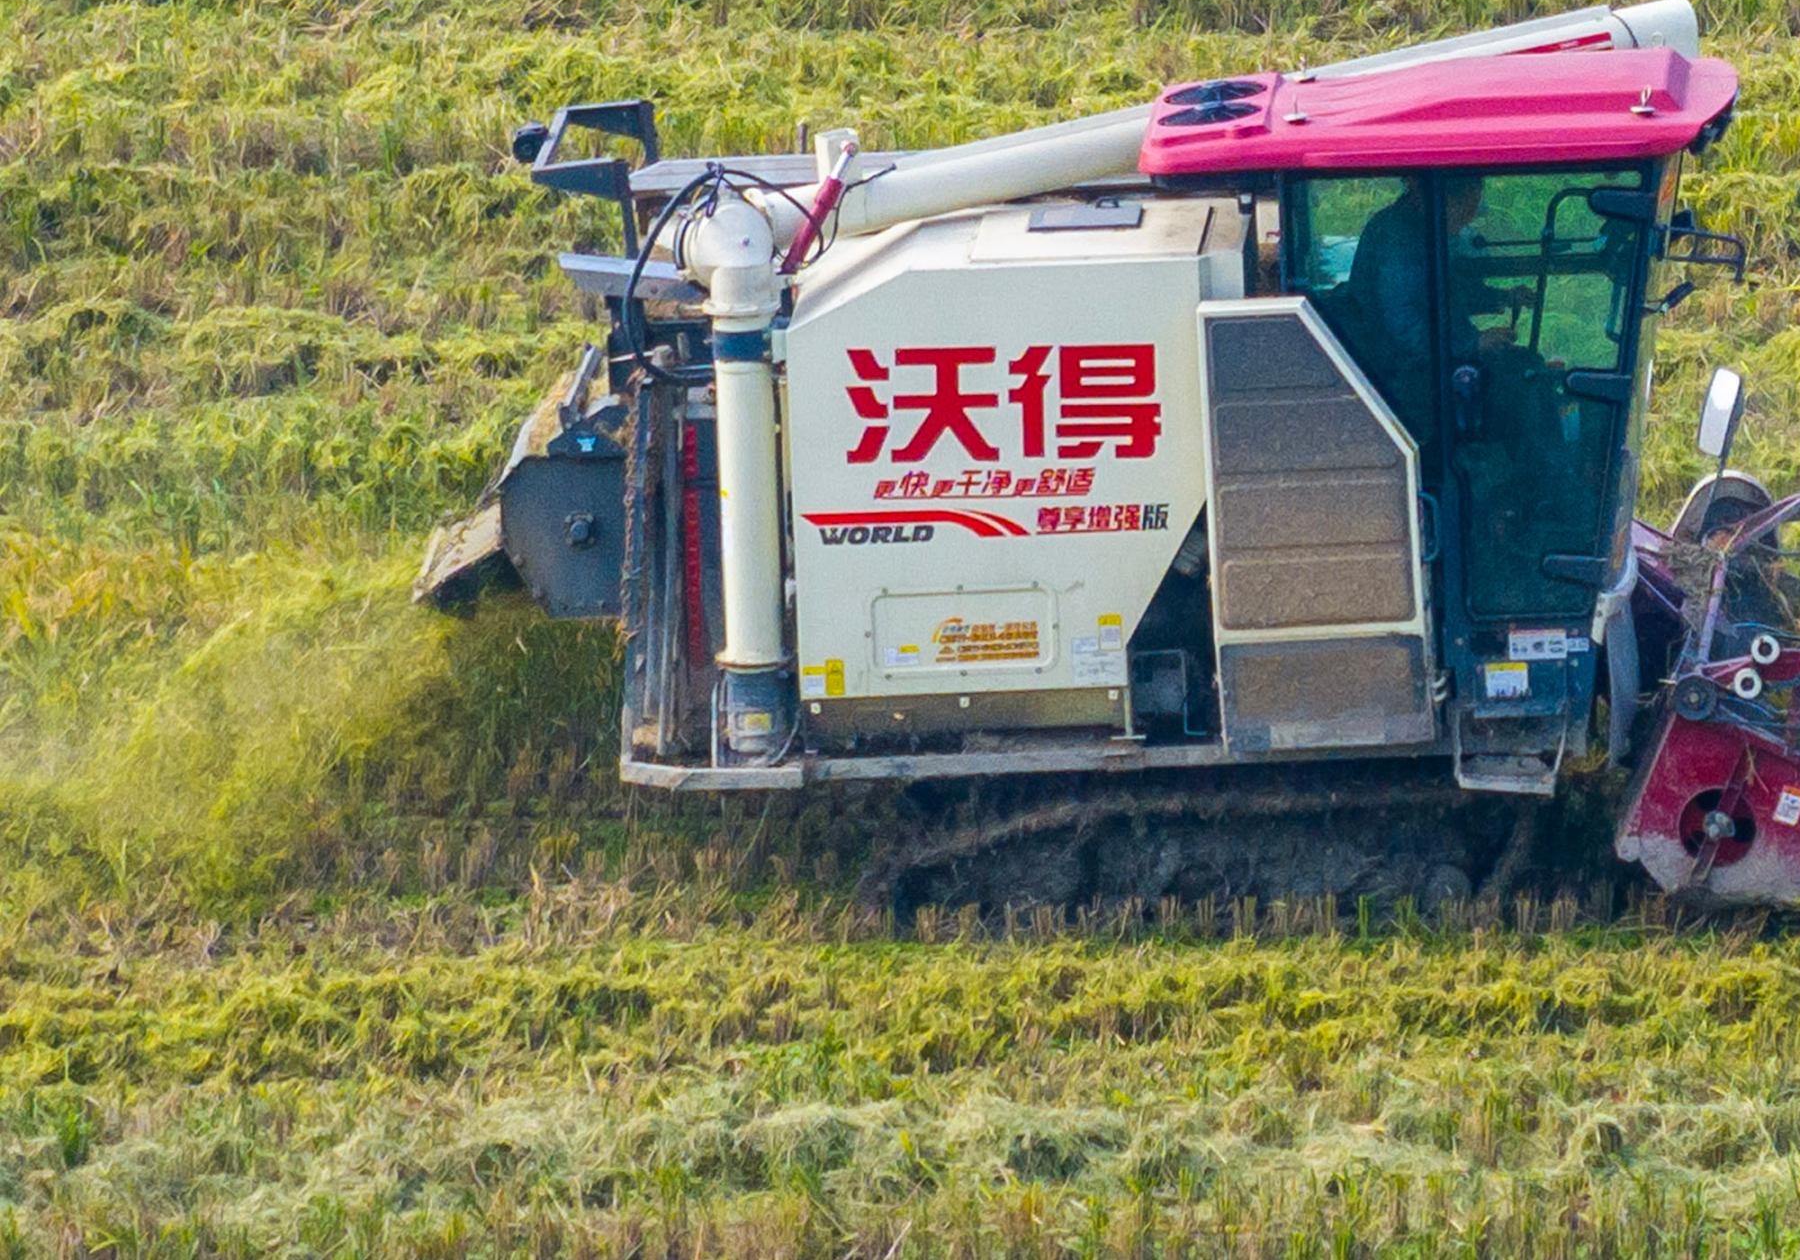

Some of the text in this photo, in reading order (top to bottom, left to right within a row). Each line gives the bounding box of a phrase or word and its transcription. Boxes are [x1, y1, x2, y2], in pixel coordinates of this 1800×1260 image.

[846, 343, 1162, 463] 沃得
[873, 467, 1096, 499] 更快更干净更舒适
[1036, 503, 1170, 535] 尊享增强版
[818, 525, 934, 546] WORLD
